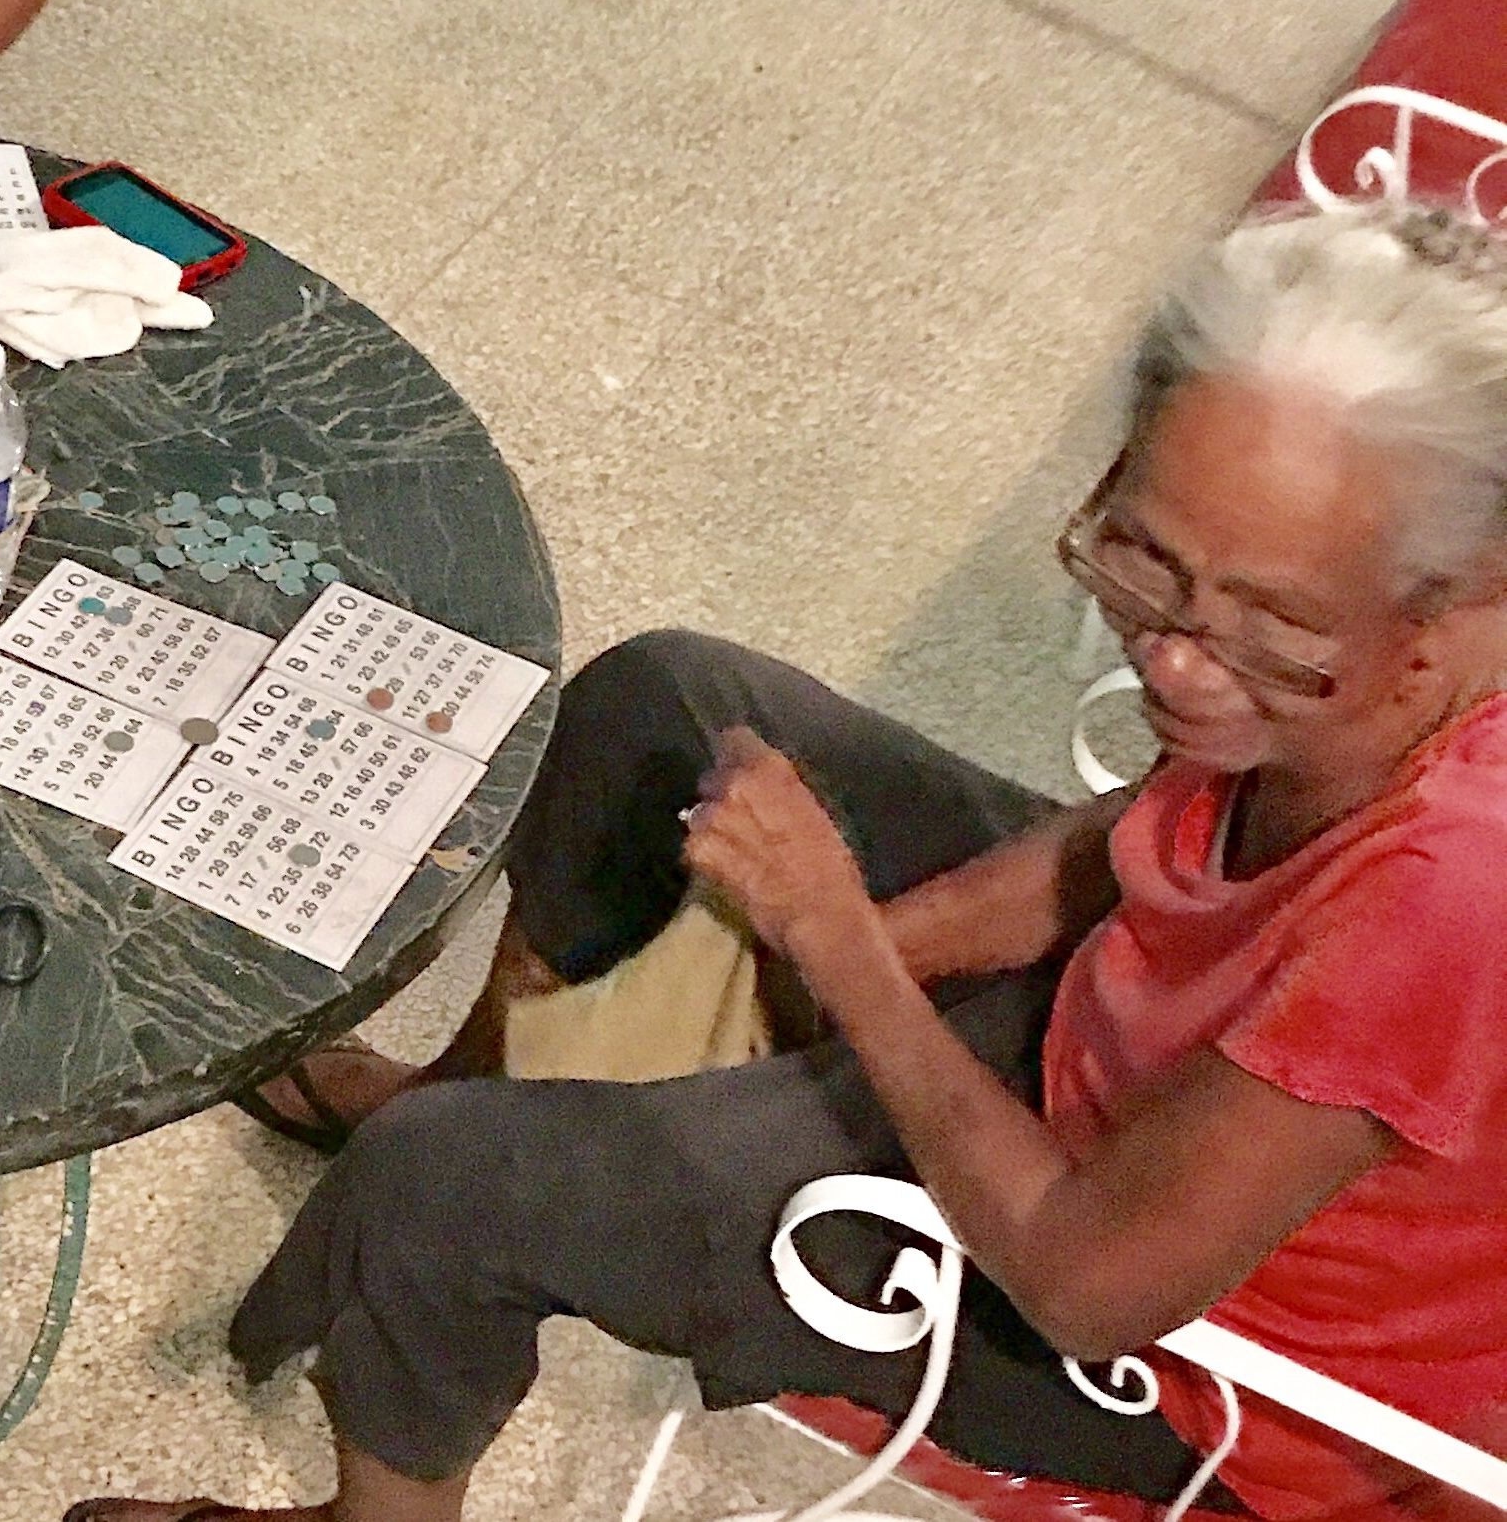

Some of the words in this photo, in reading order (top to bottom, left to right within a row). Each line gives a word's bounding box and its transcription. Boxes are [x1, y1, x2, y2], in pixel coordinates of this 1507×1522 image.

[12, 573, 88, 648] BINGO
[287, 596, 358, 672] BINGO
[436, 658, 455, 673] 54
[83, 772, 104, 789] 20
[98, 753, 118, 770] 44
[123, 718, 144, 734] 64
[211, 684, 288, 765] BINGO
[245, 767, 260, 776] 4
[256, 747, 276, 761] 19
[269, 731, 290, 746] 34
[283, 714, 303, 729] 54
[297, 698, 317, 712] 68
[272, 779, 289, 790] 5
[285, 759, 305, 774] 18
[299, 741, 318, 758] 45
[326, 709, 345, 725] 64
[299, 790, 319, 803] 13
[312, 773, 333, 789] 28
[339, 738, 358, 754] 57
[352, 722, 373, 737] 66
[329, 803, 349, 817] 12
[342, 786, 362, 800] 16
[355, 768, 375, 784] 40
[367, 752, 388, 767] 50
[381, 735, 401, 749] 61
[359, 819, 375, 829] 3
[370, 799, 391, 815] 30
[384, 782, 404, 797] 43
[397, 765, 417, 780] 48
[409, 747, 430, 763] 62
[132, 778, 214, 867] BINGO
[165, 865, 185, 880] 14
[178, 846, 201, 863] 28
[195, 828, 215, 844] 44
[208, 810, 229, 826] 58
[221, 791, 243, 807] 75
[197, 881, 213, 889] 1
[208, 860, 229, 877] 29
[222, 841, 247, 858] 32
[237, 823, 258, 839] 59
[251, 805, 272, 821] 66
[224, 894, 240, 906] 7
[238, 872, 257, 889] 17
[265, 836, 287, 853] 56
[280, 818, 301, 834] 68
[256, 909, 271, 919] 4
[266, 887, 289, 905] 22
[282, 866, 303, 886] 35
[309, 829, 331, 848] 72
[285, 923, 301, 934] 6
[296, 900, 318, 918] 26
[310, 882, 332, 899] 38
[324, 863, 346, 880] 54
[337, 843, 360, 861] 73
